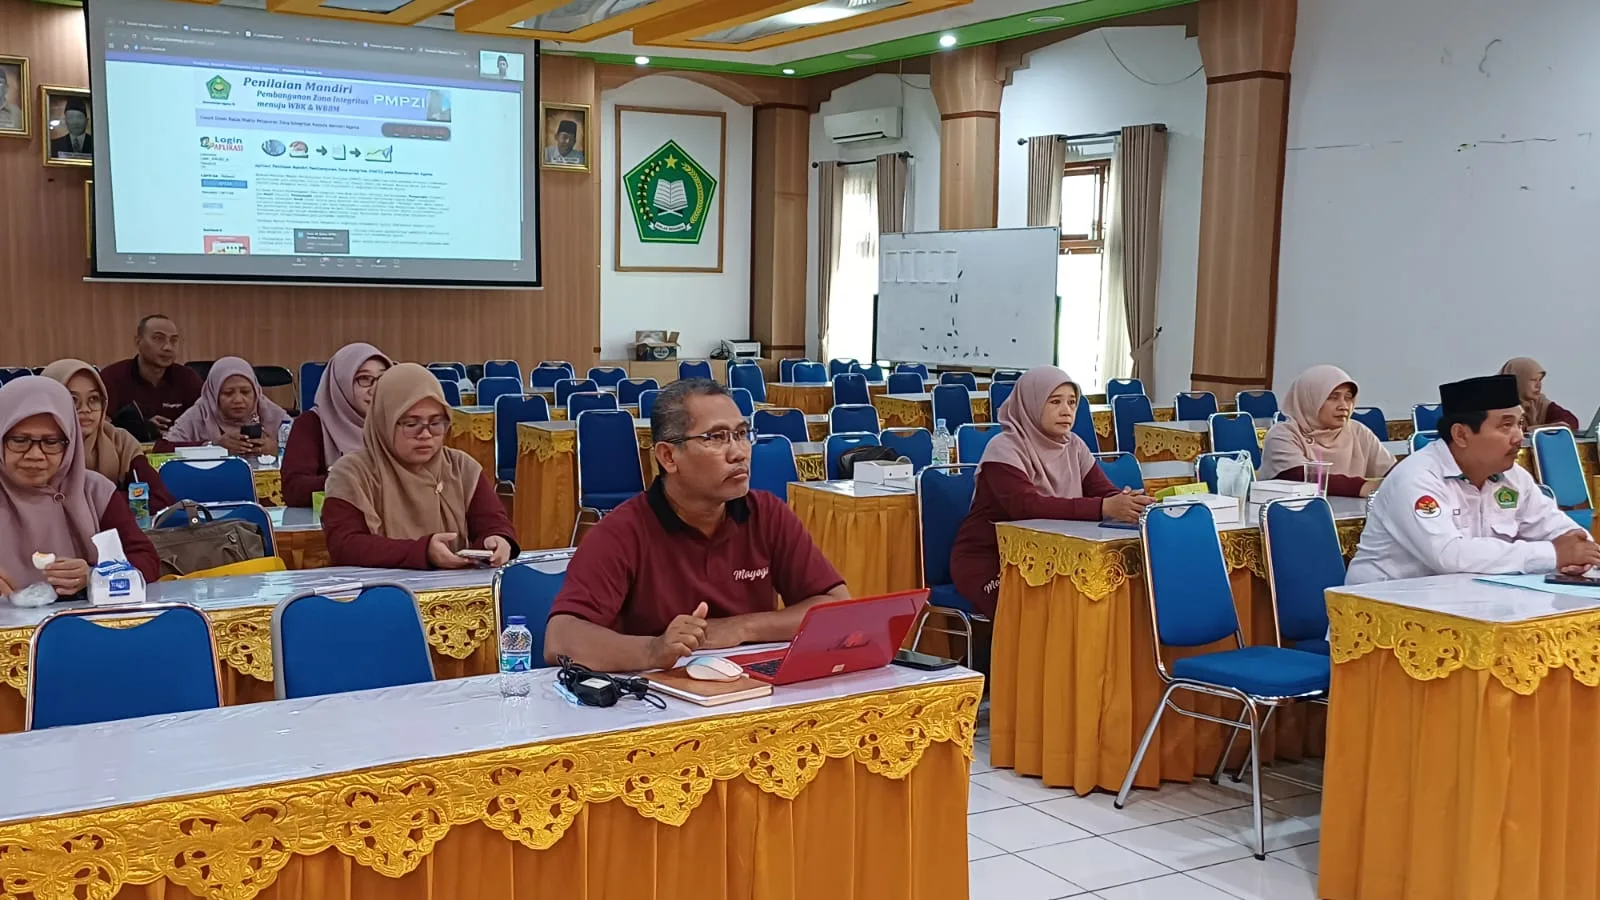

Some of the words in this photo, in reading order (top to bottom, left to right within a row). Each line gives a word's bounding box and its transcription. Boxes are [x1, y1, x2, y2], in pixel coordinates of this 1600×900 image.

[243, 77, 302, 90] Penilaian
[305, 81, 353, 94] Mandiri
[257, 101, 286, 110] menuju
[373, 95, 425, 109] PMPZI
[215, 136, 243, 145] Login
